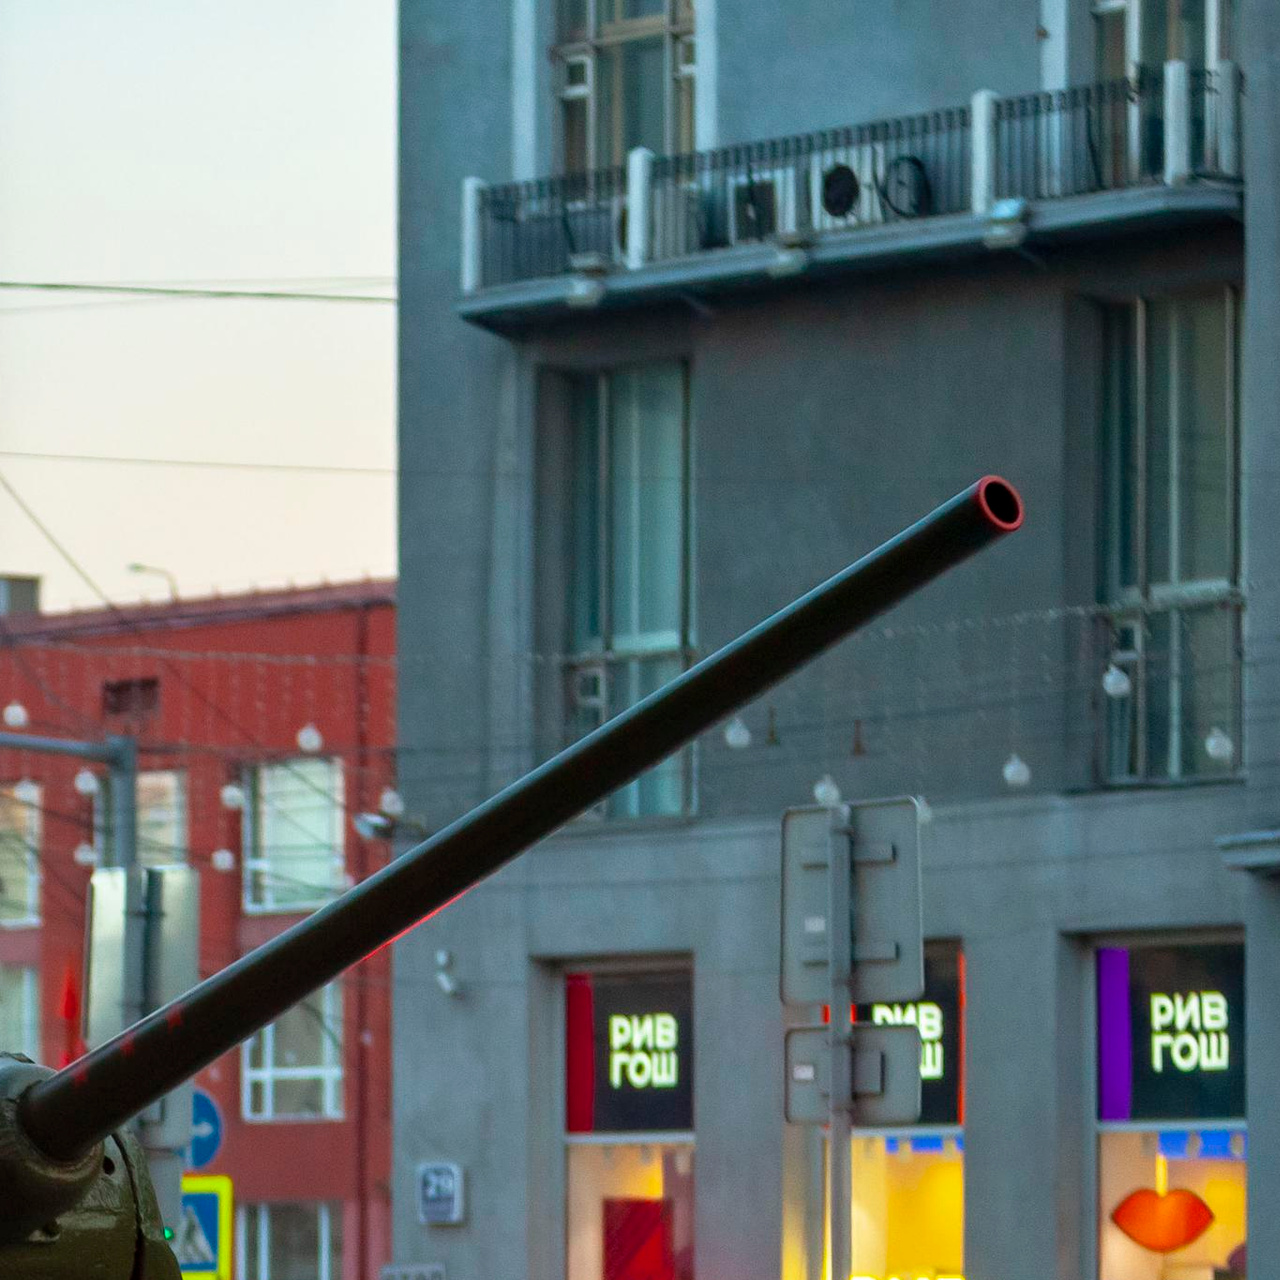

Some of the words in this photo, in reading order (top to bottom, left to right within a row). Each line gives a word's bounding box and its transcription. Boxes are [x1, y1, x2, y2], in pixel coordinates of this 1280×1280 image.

[1150, 991, 1229, 1031] РИВ
[609, 1013, 678, 1050] РИВ
[609, 1050, 678, 1090] ГОШ
[1150, 1031, 1230, 1073] ГОШ
